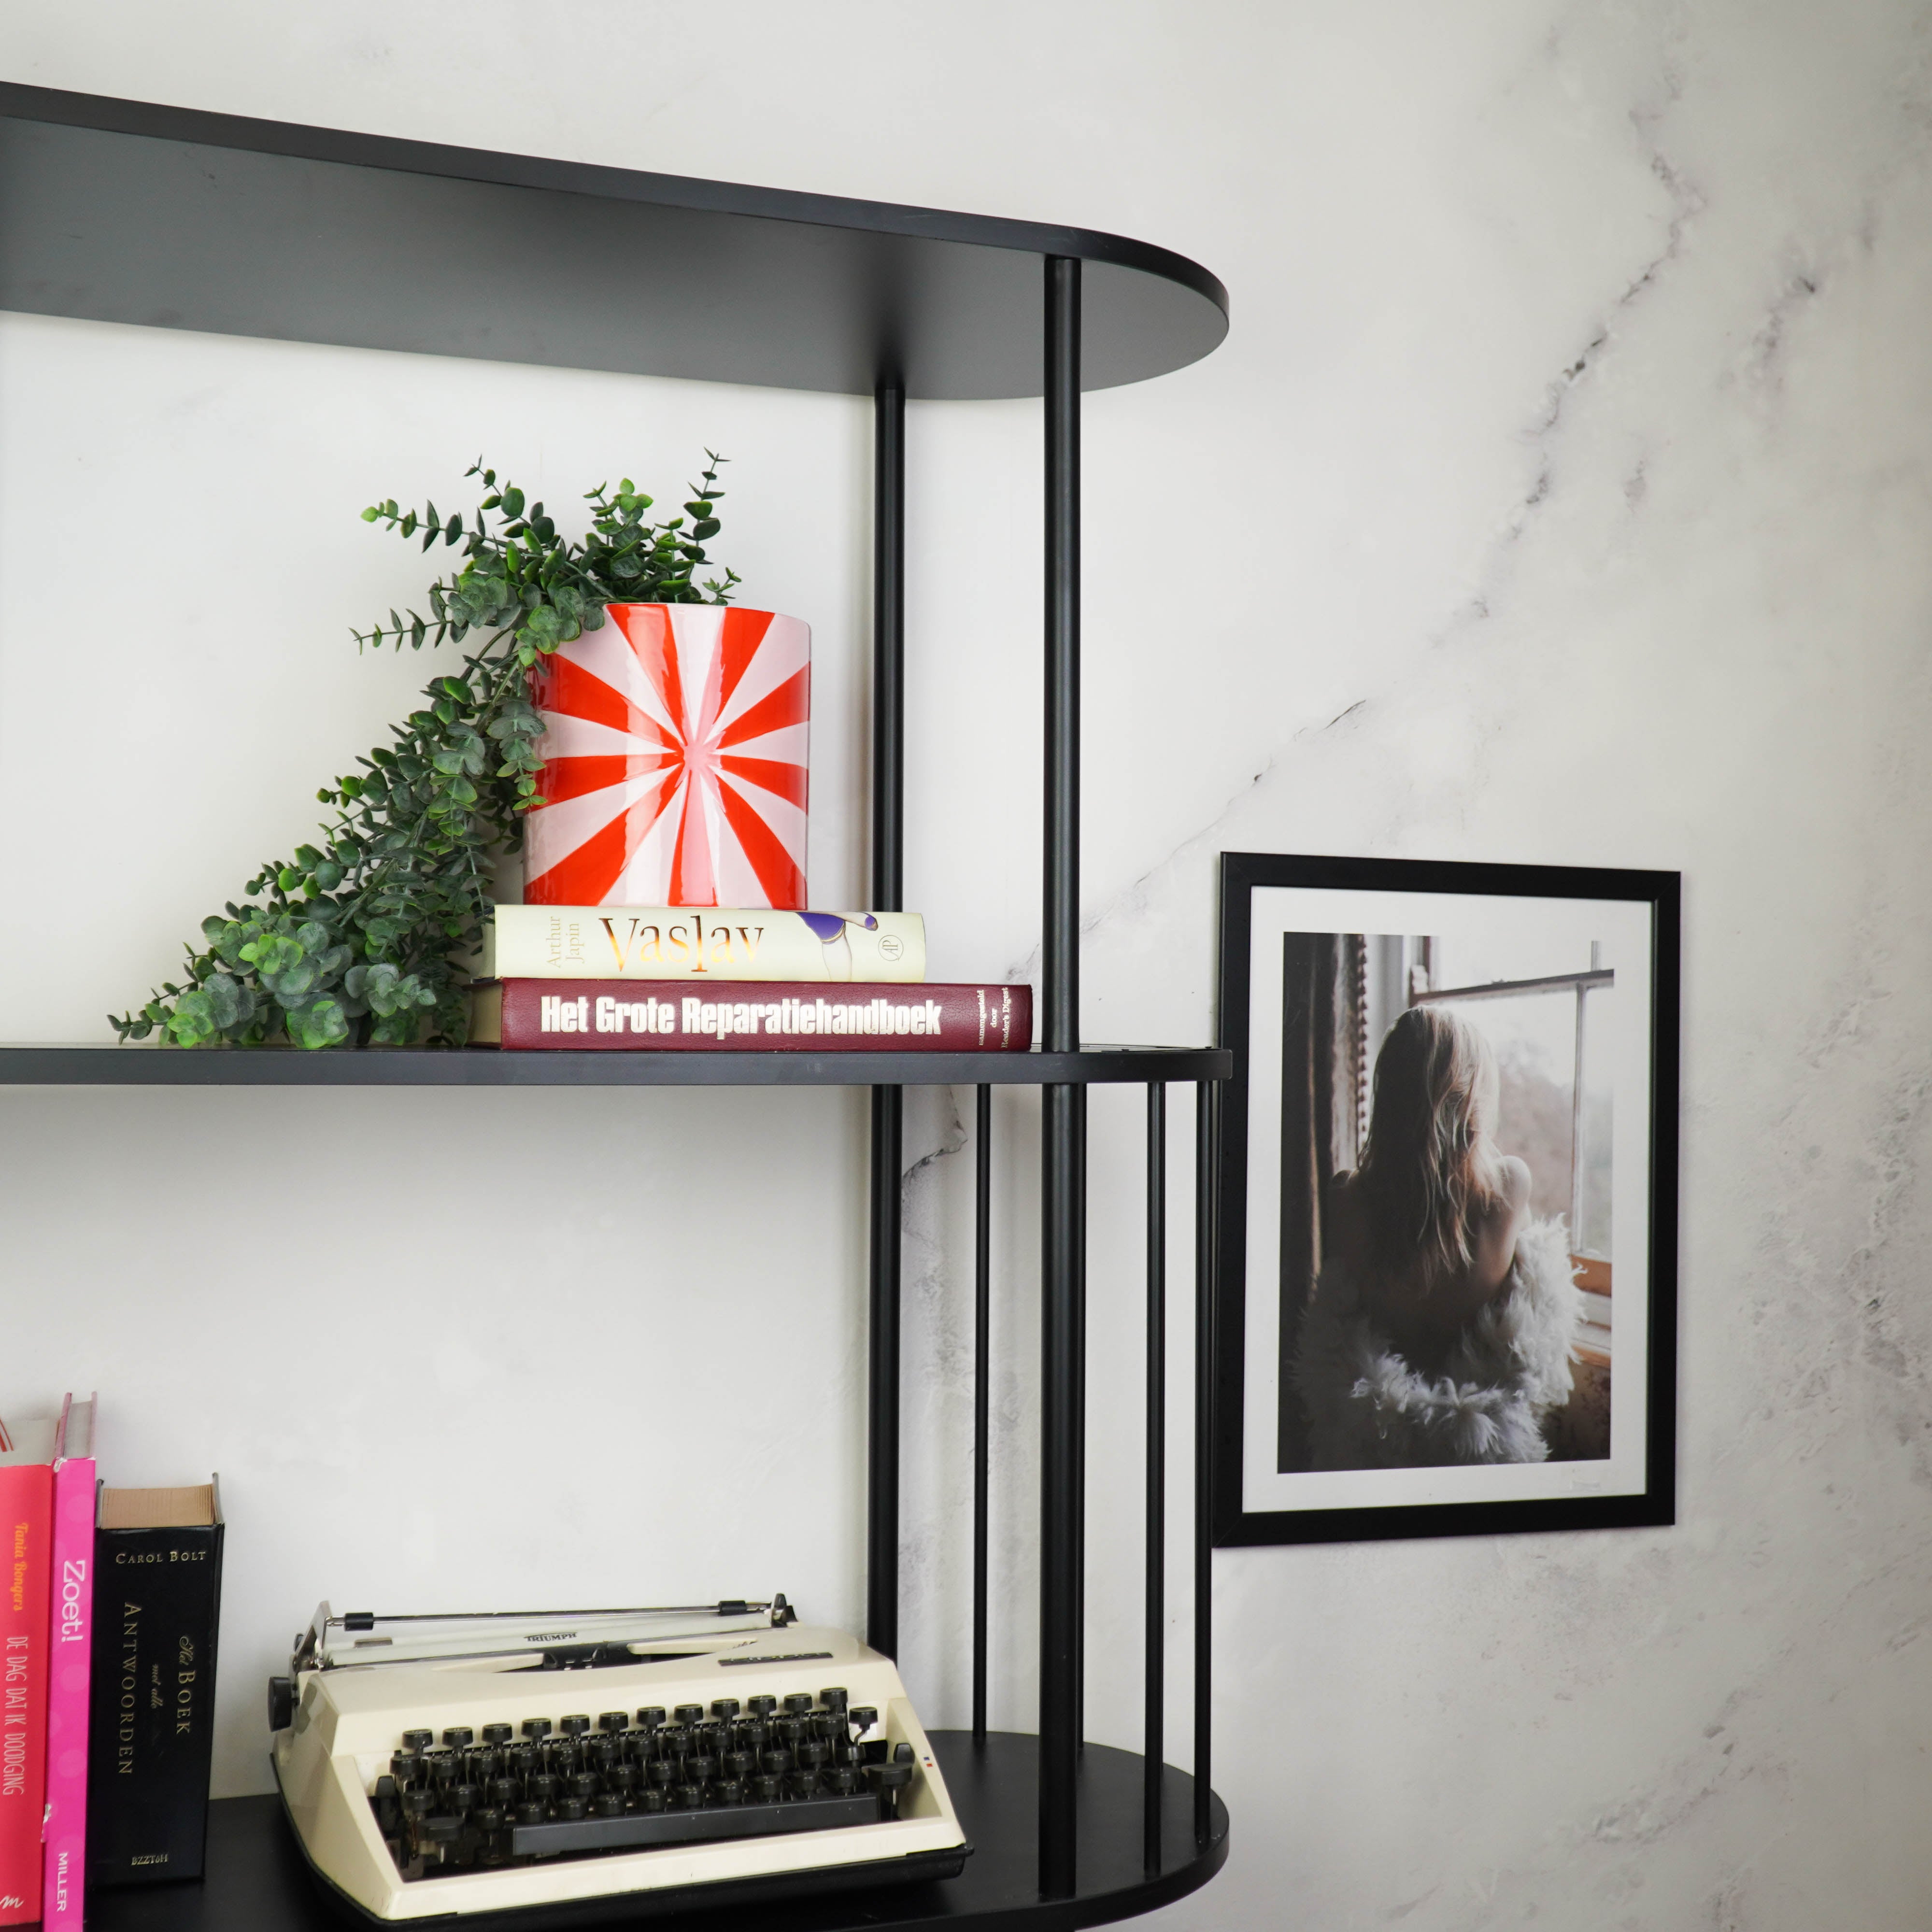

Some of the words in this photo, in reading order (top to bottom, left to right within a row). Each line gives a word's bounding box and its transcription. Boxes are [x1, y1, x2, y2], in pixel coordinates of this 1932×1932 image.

[546, 916, 561, 968] Arthur
[565, 923, 585, 964] Japin
[598, 915, 765, 972] Vaslav
[1001, 987, 1011, 1013] Digest
[540, 996, 588, 1033] Het
[596, 996, 675, 1034] Grote
[682, 997, 942, 1040] Reparatiehandboek
[14, 1522, 29, 1559] Tania
[115, 1553, 163, 1564] CAROL
[169, 1550, 207, 1562] BOLT
[61, 1560, 86, 1643] Zoet!
[6, 1636, 28, 1650] DE
[178, 1636, 194, 1666] Het
[524, 1632, 578, 1642] TRIUMPH
[5, 1656, 28, 1682] DAG
[151, 1663, 161, 1686] met
[5, 1688, 27, 1709] DAT
[118, 1602, 142, 1774] ANTWOORDEN
[151, 1689, 164, 1709] alle
[176, 1669, 197, 1735] BOEK
[4, 1714, 27, 1726] IK
[2, 1732, 26, 1796] DOODGING
[56, 1852, 69, 1913] MILLER
